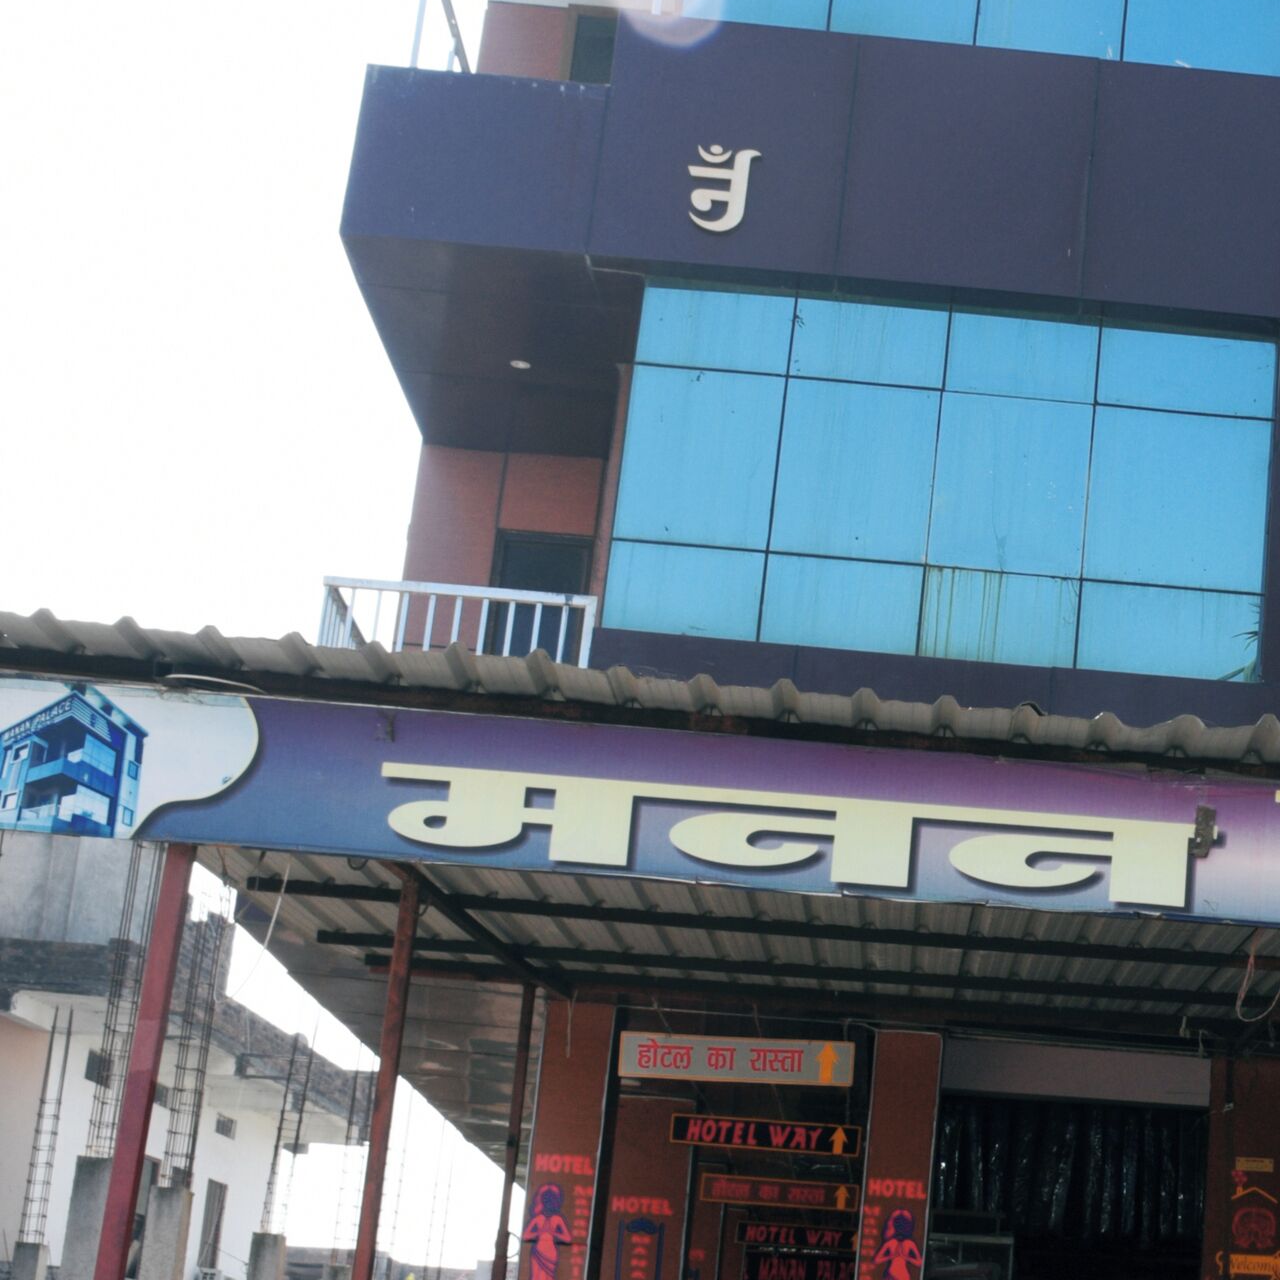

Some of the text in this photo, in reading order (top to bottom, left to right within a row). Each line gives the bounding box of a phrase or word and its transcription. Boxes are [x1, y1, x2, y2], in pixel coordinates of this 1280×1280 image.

[382, 762, 1217, 907] मनन
[638, 1039, 804, 1073] होटल का रास्ता
[686, 1119, 823, 1150] HOTEL WAY
[535, 1153, 594, 1176] HOTEL
[867, 1177, 926, 1201] HOTEL
[611, 1195, 673, 1216] HOTEL
[745, 1225, 842, 1248] HOTEL WAY
